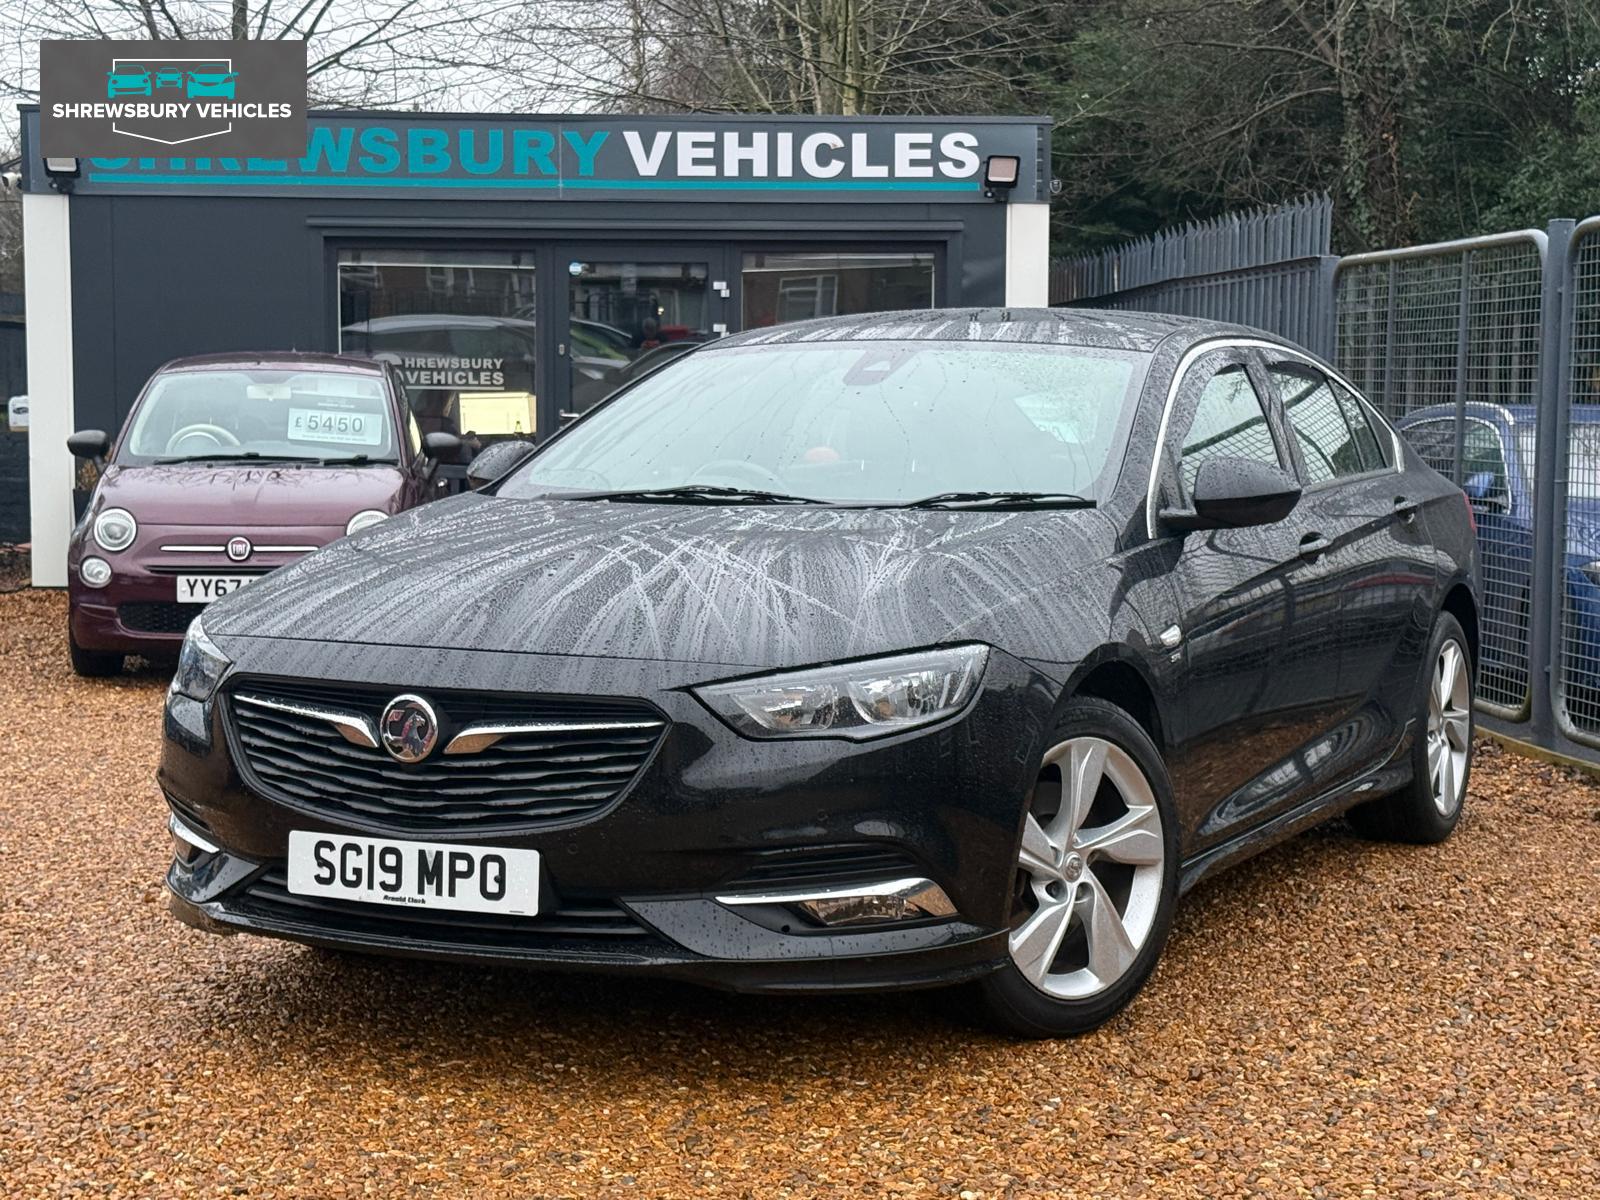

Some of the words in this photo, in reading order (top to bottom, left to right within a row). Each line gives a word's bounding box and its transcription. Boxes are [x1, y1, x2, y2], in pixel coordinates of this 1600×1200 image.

[622, 131, 981, 178] VEHICLES
[405, 370, 505, 385] VEHICLES
[313, 840, 403, 893] SG19
